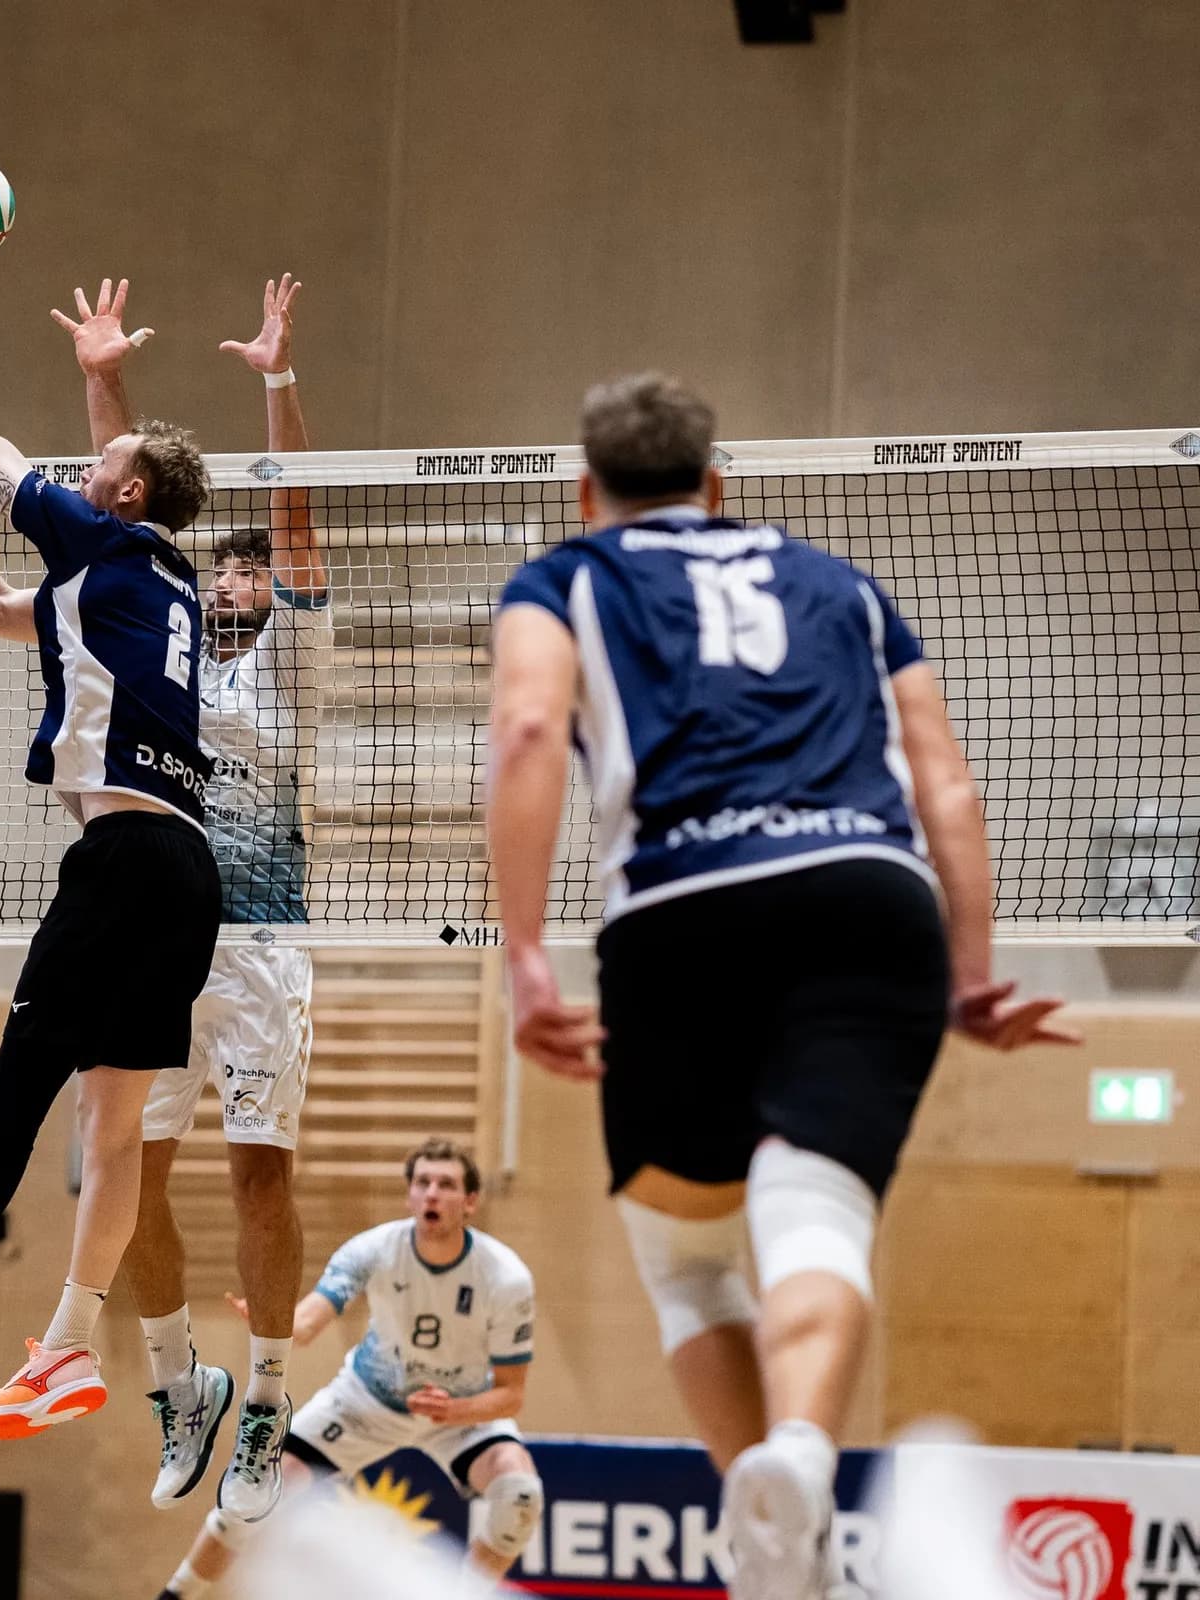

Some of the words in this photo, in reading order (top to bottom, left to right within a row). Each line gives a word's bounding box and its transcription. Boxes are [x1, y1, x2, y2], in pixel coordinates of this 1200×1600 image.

[416, 454, 485, 476] EINTRACHT
[490, 452, 556, 474] SPONTENT
[873, 442, 948, 464] EINTRACHT
[952, 440, 1023, 462] SPONTENT
[684, 555, 789, 676] 15
[164, 602, 192, 690] 2
[412, 1314, 440, 1348] 8
